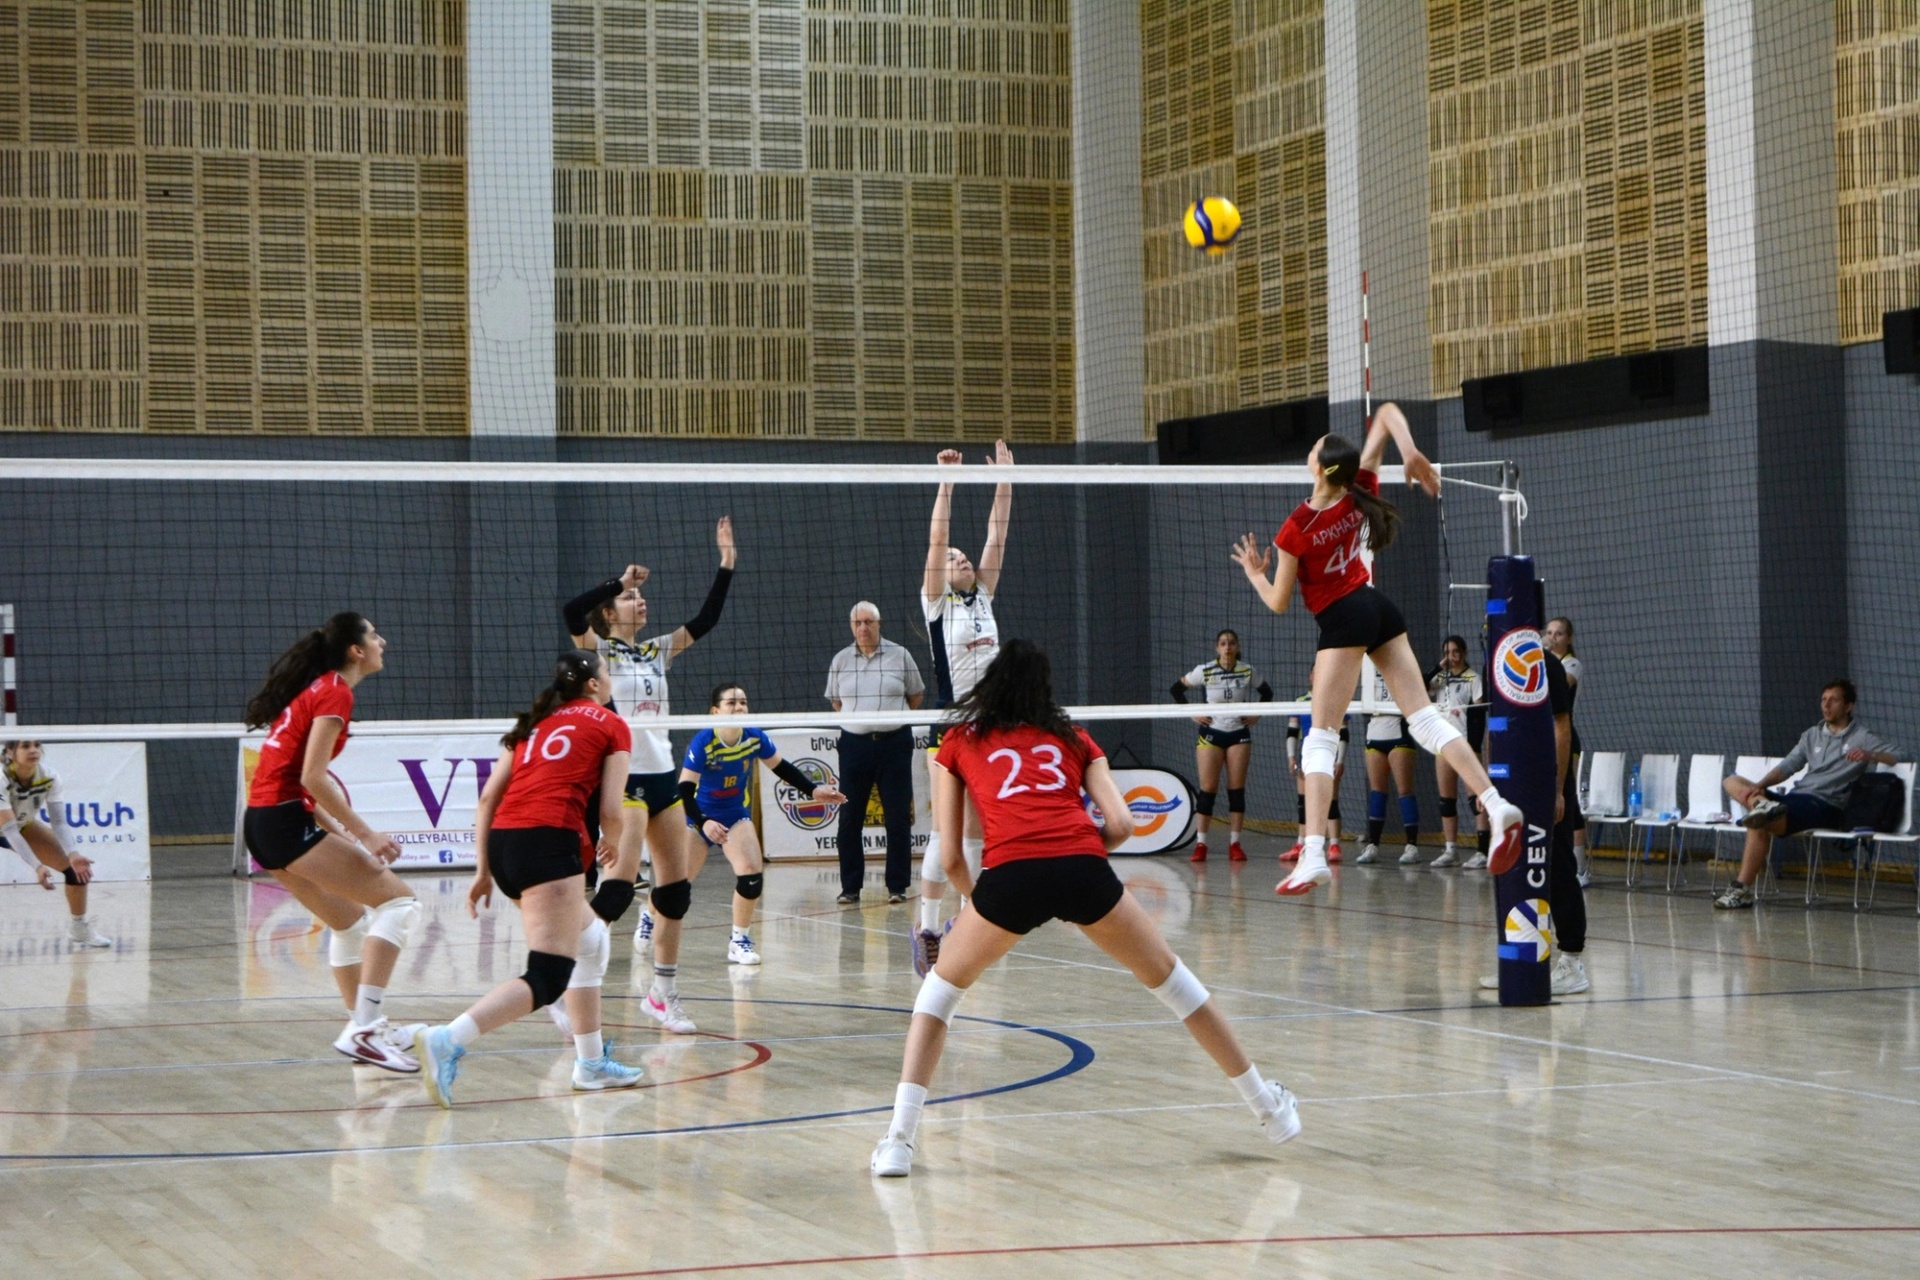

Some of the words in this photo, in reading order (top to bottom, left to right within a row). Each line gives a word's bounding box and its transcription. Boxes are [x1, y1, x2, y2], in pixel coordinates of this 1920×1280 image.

[644, 678, 653, 696] 8
[523, 725, 577, 765] 16
[987, 744, 1067, 799] 23
[1527, 823, 1547, 888] CEV
